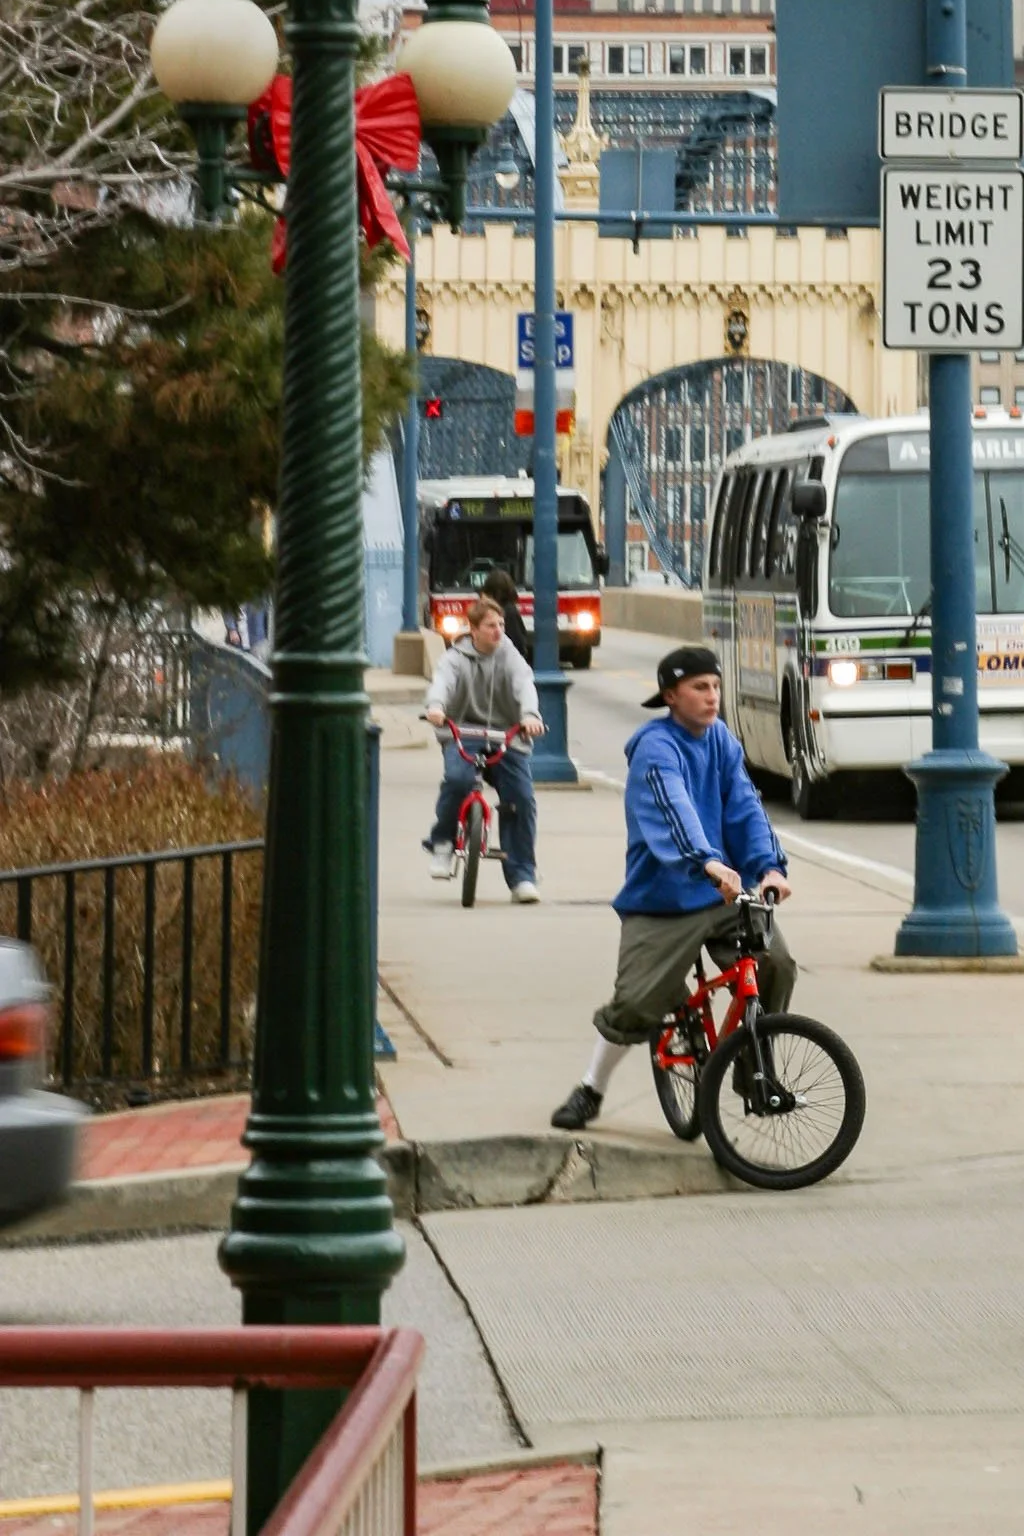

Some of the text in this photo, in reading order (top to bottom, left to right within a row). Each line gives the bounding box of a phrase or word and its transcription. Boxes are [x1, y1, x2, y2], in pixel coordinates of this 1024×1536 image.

[895, 111, 1008, 139] BRIDGE
[899, 183, 1014, 211] WEIGHT
[915, 220, 994, 246] LIMIT
[927, 258, 982, 290] 23
[903, 301, 1005, 335] TONS
[521, 340, 571, 363] Sp
